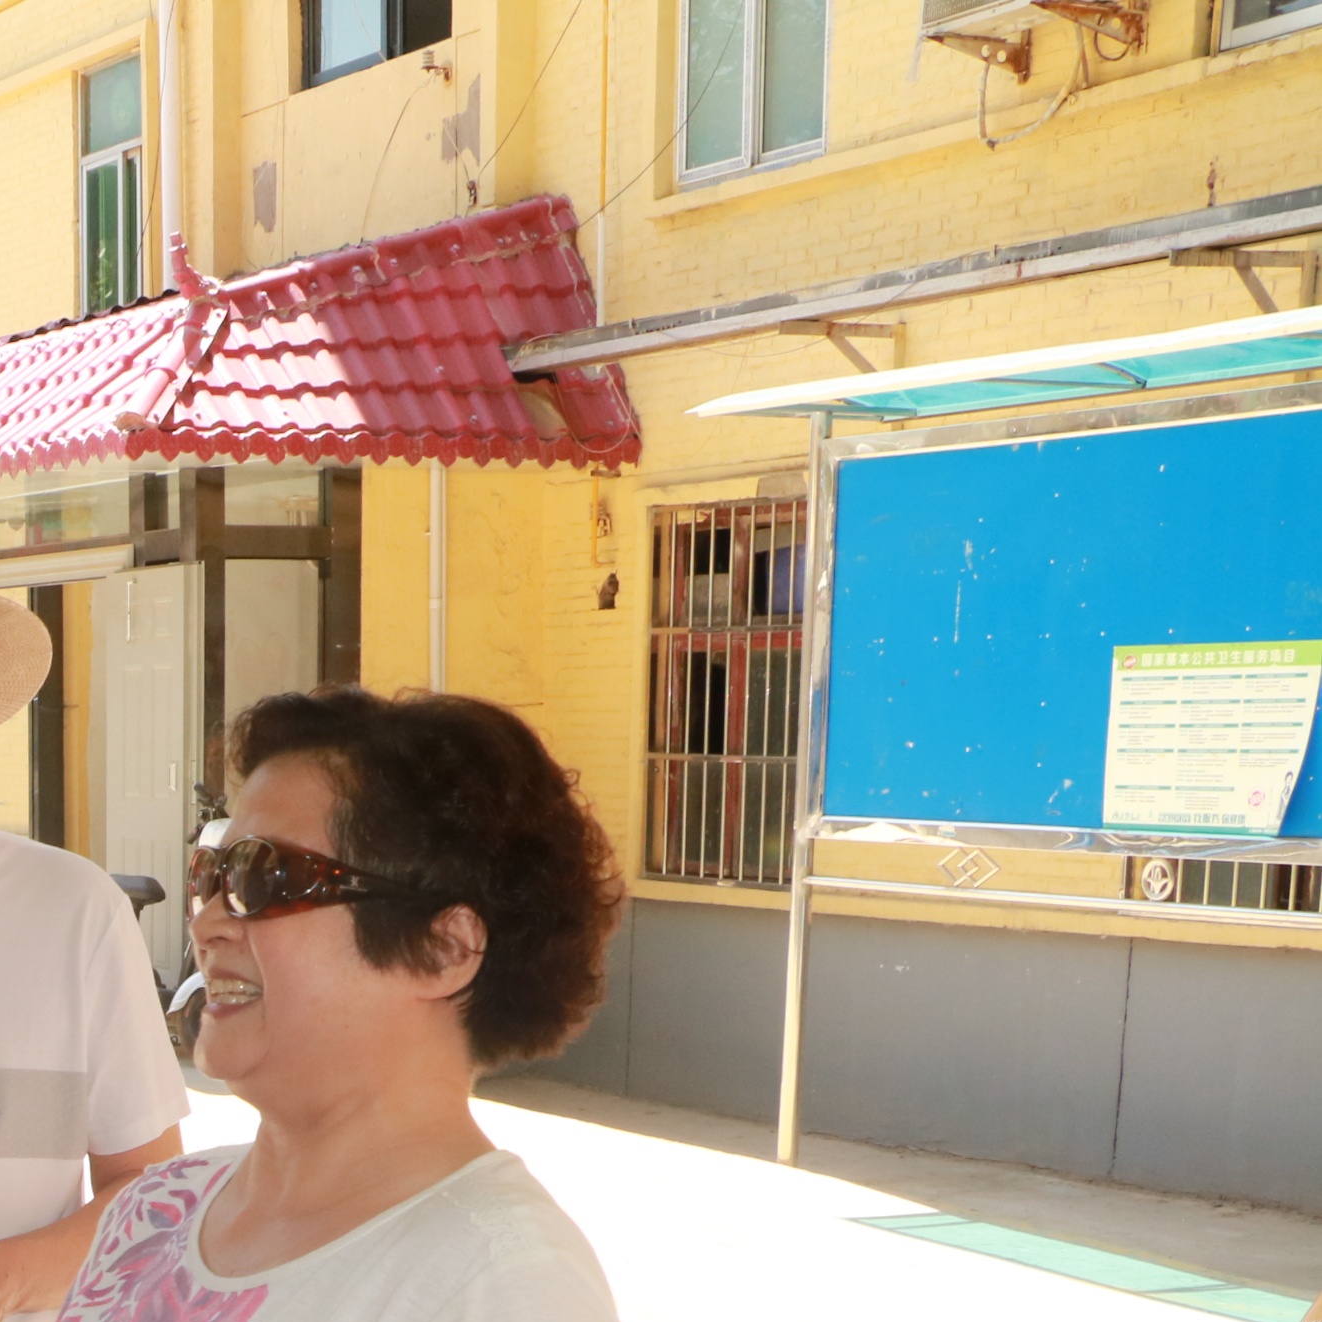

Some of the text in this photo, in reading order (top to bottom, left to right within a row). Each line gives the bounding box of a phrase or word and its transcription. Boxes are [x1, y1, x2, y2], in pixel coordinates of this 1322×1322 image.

[1141, 649, 1296, 667] 国家基本公共卫生服务项目
